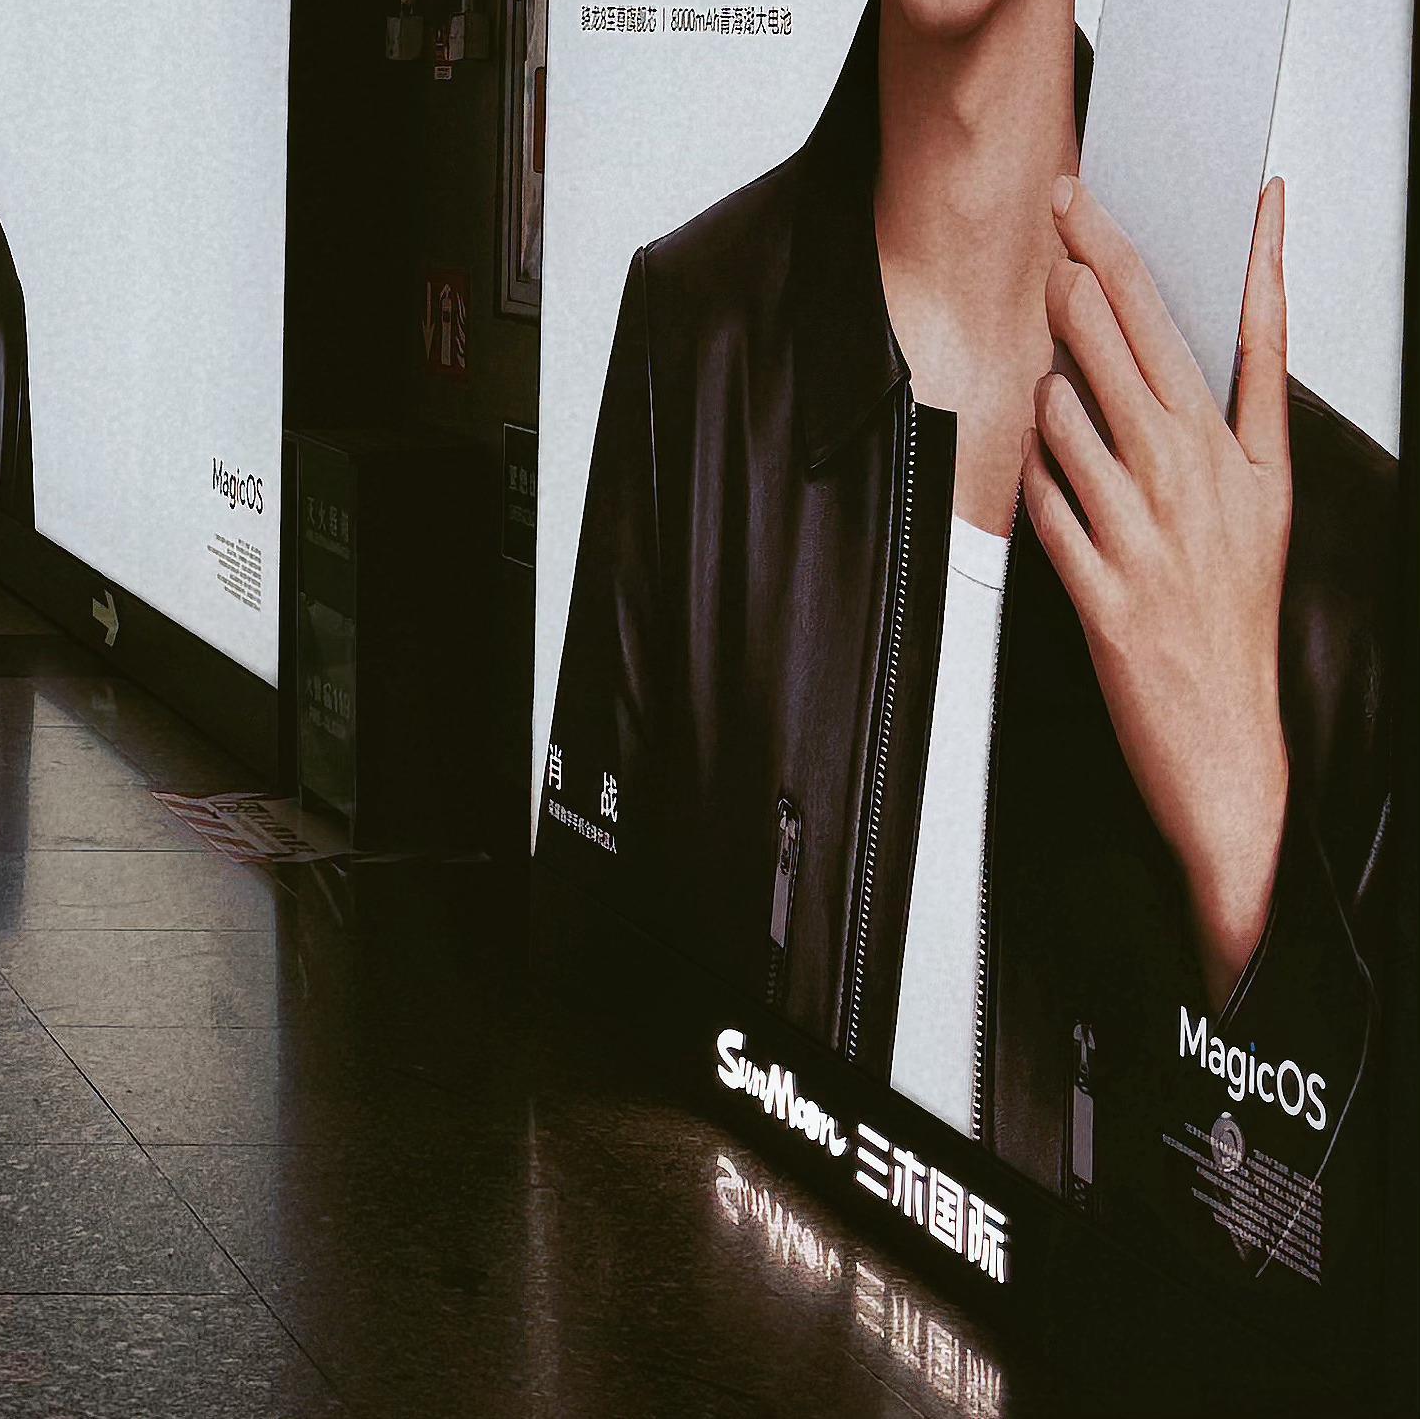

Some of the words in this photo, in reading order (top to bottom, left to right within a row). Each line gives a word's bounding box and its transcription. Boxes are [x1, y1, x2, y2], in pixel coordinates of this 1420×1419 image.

[212, 457, 264, 514] MagicOS
[1179, 1005, 1328, 1131] MagicOS
[716, 1029, 850, 1157] SunMoon
[856, 1122, 1009, 1284] 三木国际
